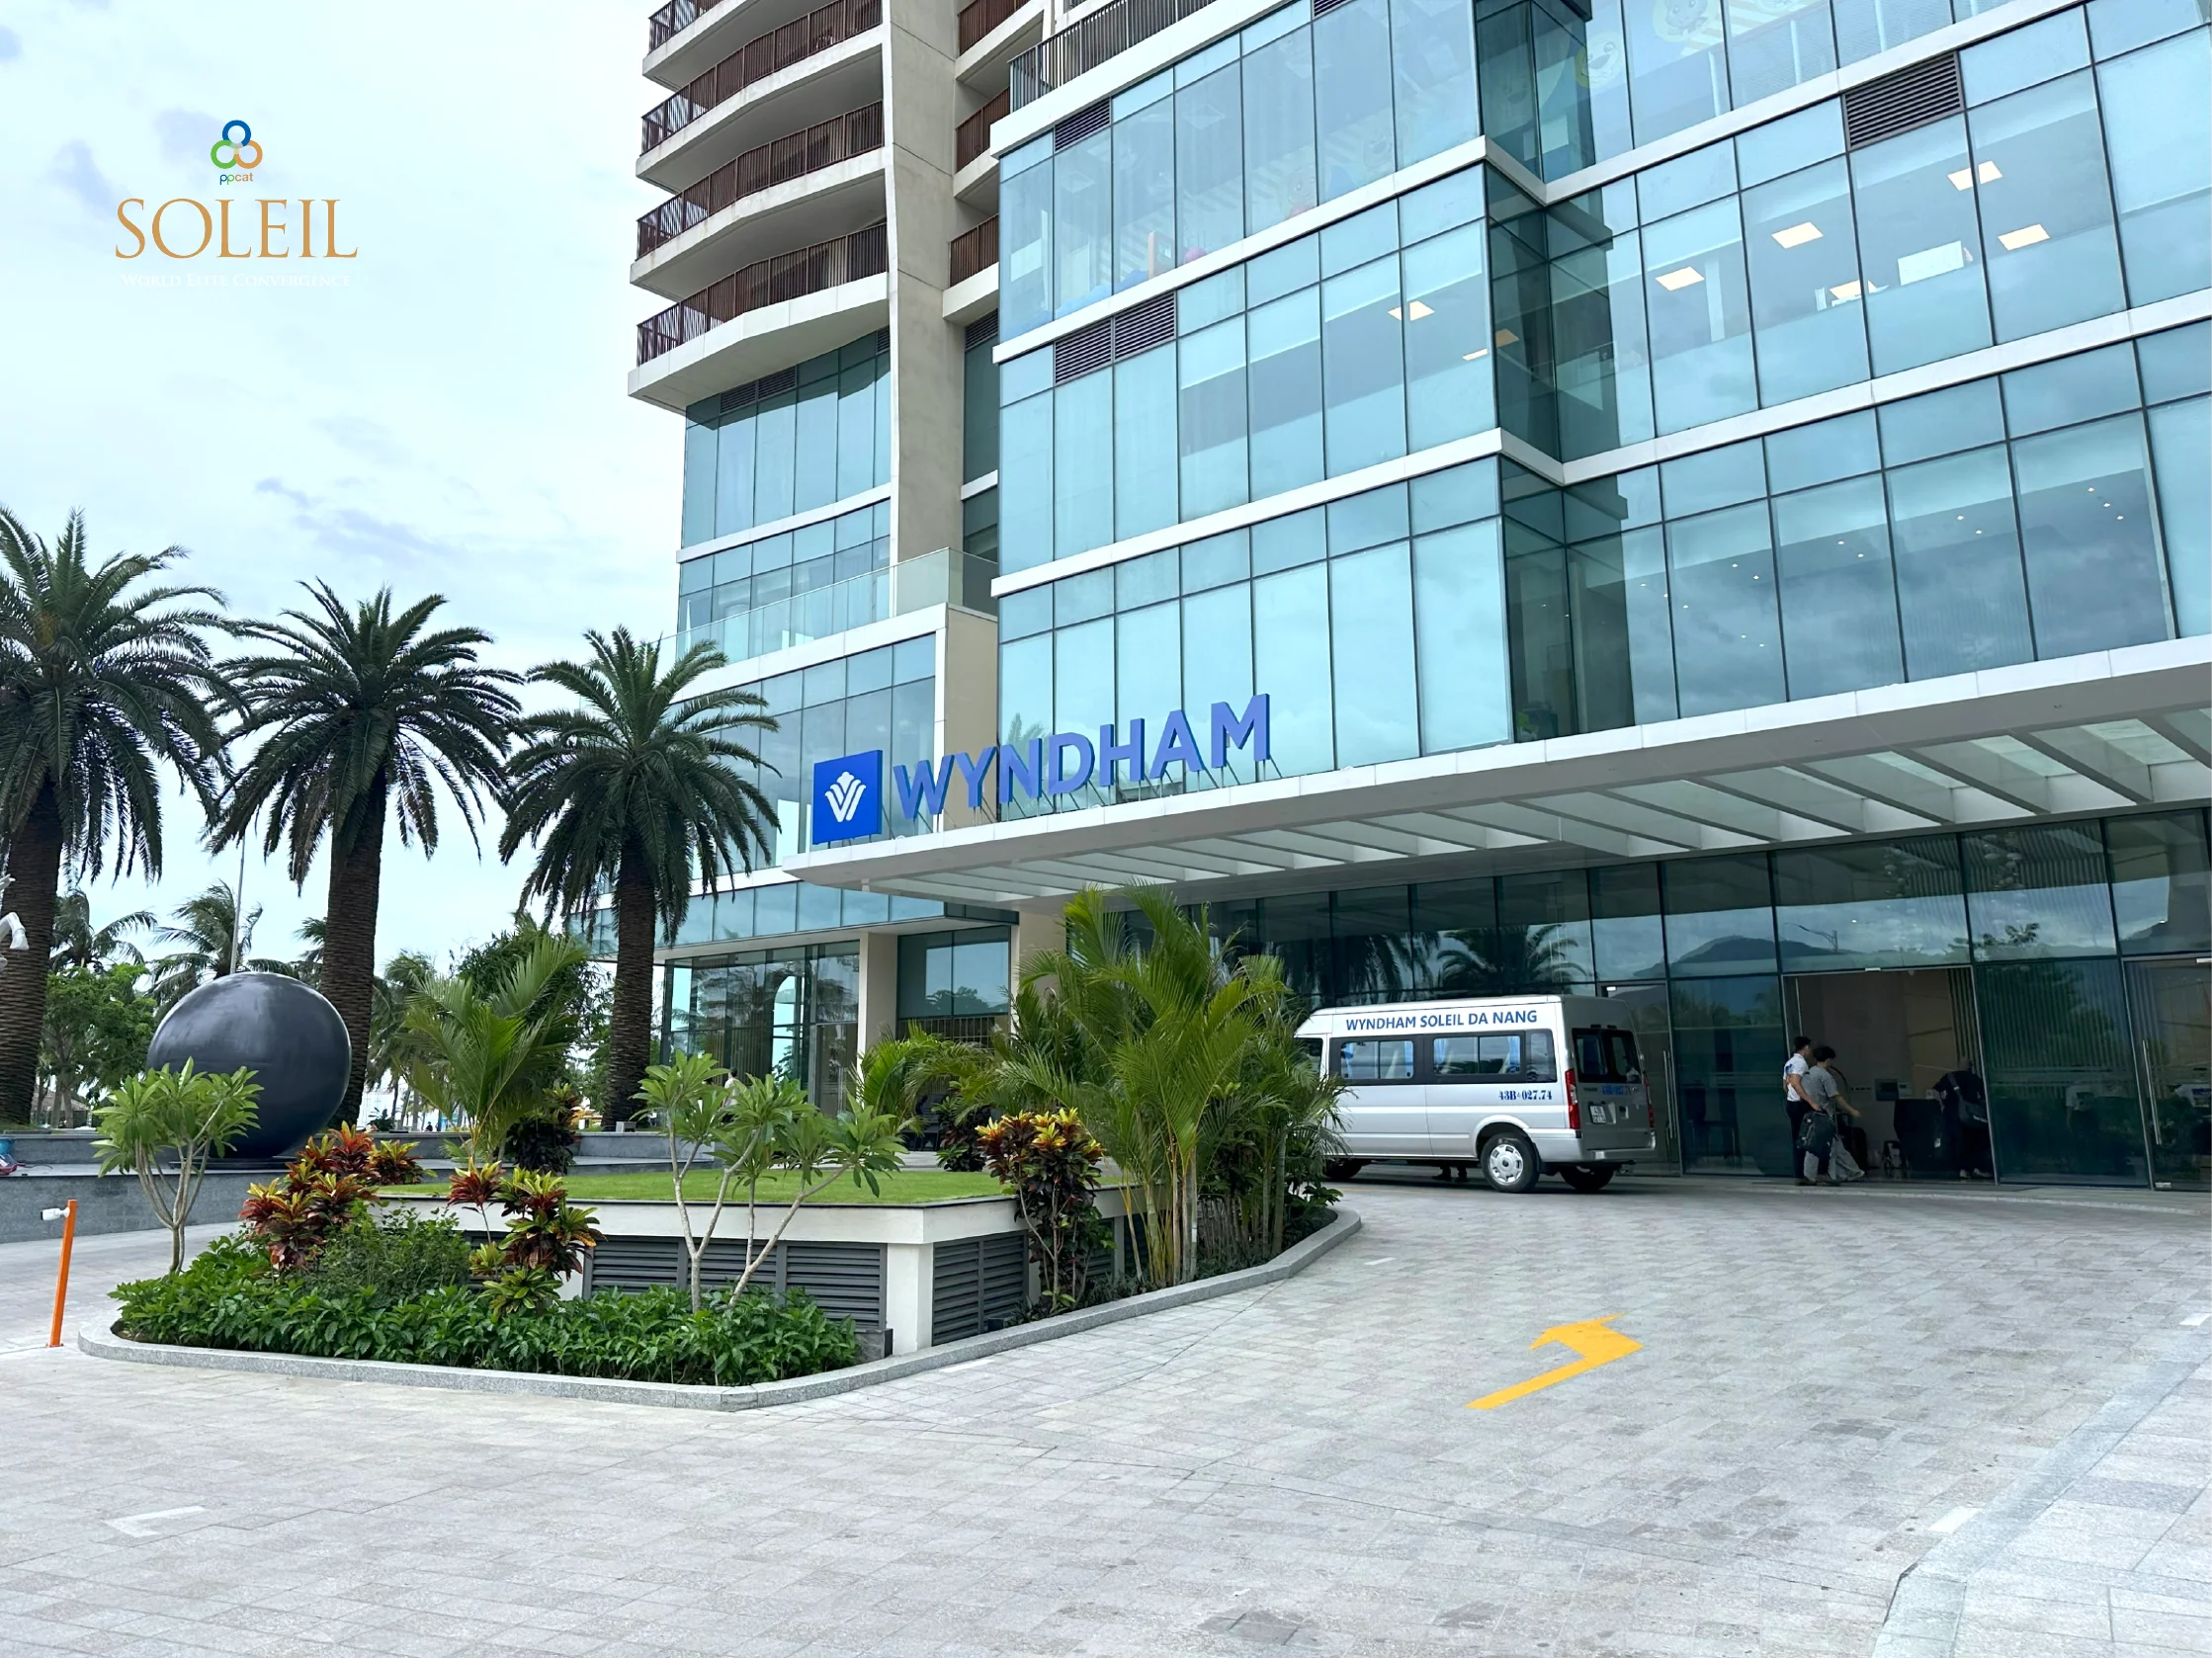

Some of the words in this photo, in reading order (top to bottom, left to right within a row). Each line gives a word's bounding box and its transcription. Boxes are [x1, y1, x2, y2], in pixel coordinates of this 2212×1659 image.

[893, 694, 1271, 820] WYNDHAM
[1345, 1016, 1416, 1031] WYNDHAM
[1419, 1014, 1465, 1028] SOLEIL
[1468, 1012, 1489, 1025] DA
[1492, 1010, 1538, 1024] NANG
